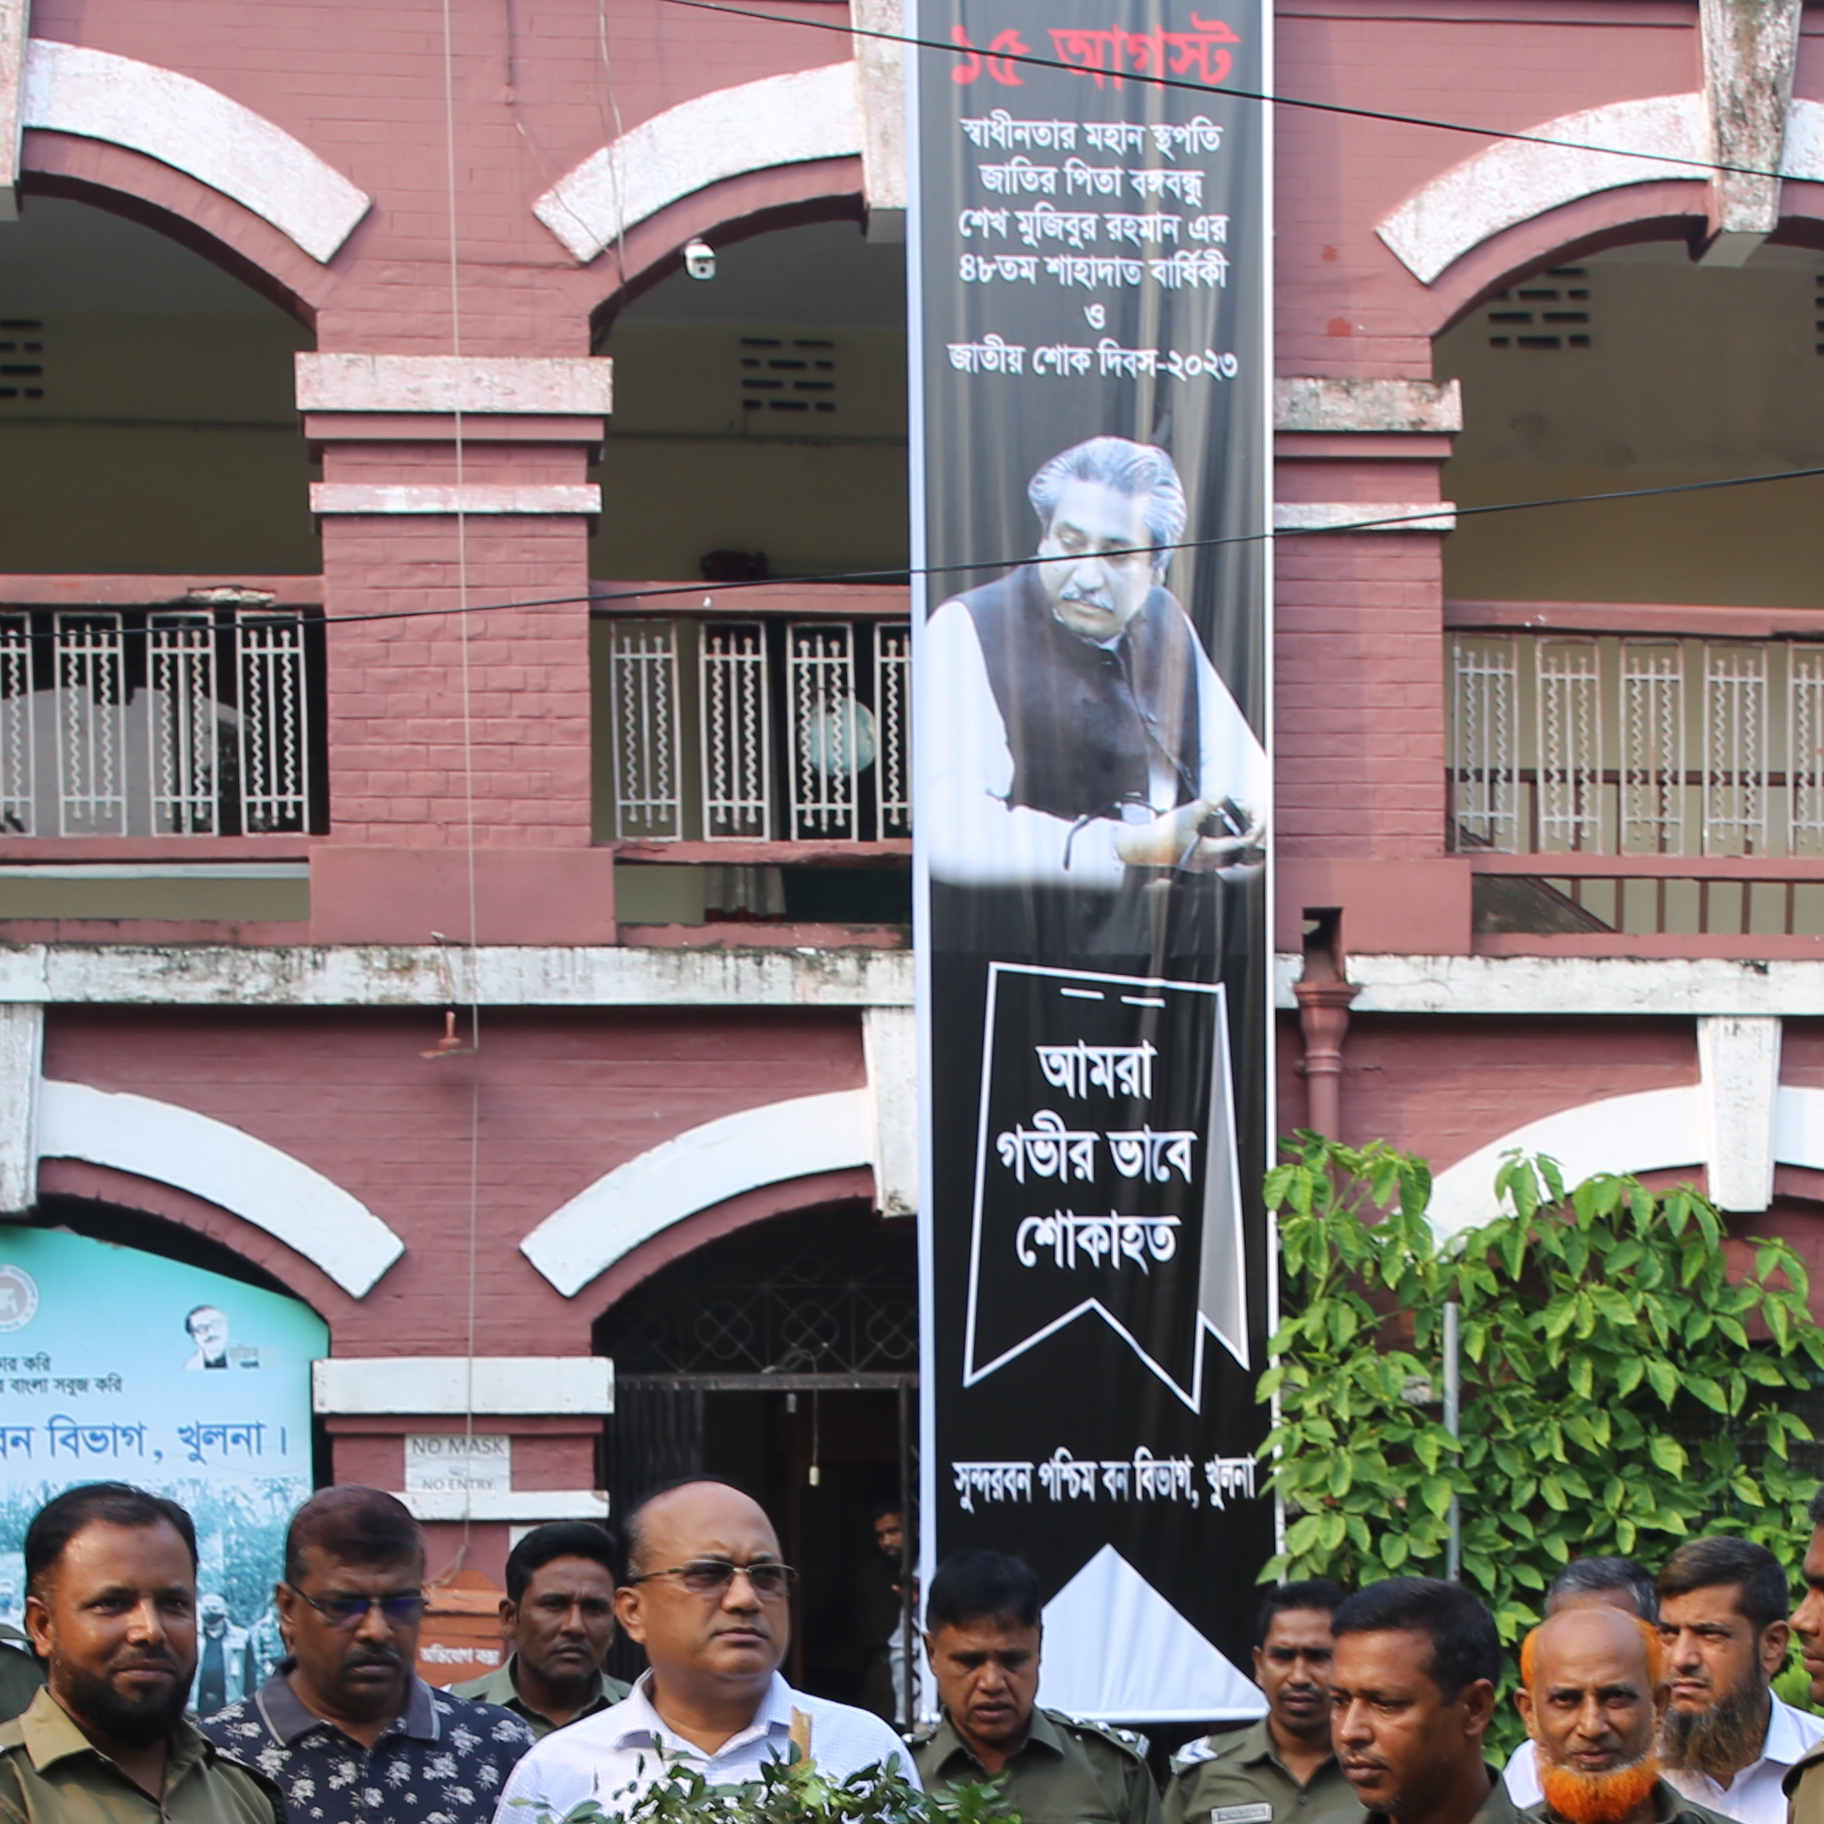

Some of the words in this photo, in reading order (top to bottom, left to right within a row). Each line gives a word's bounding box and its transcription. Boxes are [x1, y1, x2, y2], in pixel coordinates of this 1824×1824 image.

[950, 24, 1031, 86] ১৫
[1048, 12, 1241, 90] আগস্ট
[960, 109, 1077, 151] স্বাধীনতার
[1083, 121, 1146, 156] মহান
[1150, 115, 1223, 160] স্থপতি
[979, 155, 1059, 196] জাতির
[1063, 157, 1124, 197] পিতা
[1129, 168, 1205, 208] বঙ্গবন্ধু
[958, 206, 1009, 240] শেখ
[1015, 200, 1100, 248] মুজিবুর
[1104, 211, 1182, 247] রহমান
[1187, 213, 1229, 244] এর
[959, 254, 1038, 285] ৪৮তম
[1044, 255, 1144, 291] শাহাদাত
[1149, 247, 1230, 289] বার্ষিকী
[1084, 303, 1106, 330] ও
[946, 333, 1026, 375] জাতীয়
[1032, 342, 1092, 377] শোক
[1097, 337, 1239, 382] দিবস-২০২৩
[1034, 1039, 1159, 1100] আমরা
[996, 1109, 1102, 1184] গভীর
[1105, 1124, 1198, 1184] ভাবে
[1016, 1208, 1182, 1275] শোকাহত
[9, 1376, 49, 1395] বাংলা
[53, 1377, 90, 1398] সবুজ
[93, 1372, 123, 1394] করি
[22, 1351, 52, 1373] করি
[413, 1438, 441, 1454] NO
[449, 1438, 505, 1455] MASK
[422, 1478, 444, 1491] NO
[952, 1461, 1034, 1514] সুন্দরবন
[1038, 1446, 1099, 1502] পশ্চিম
[1099, 1461, 1132, 1502] বন
[1204, 1453, 1258, 1511] খুলনা
